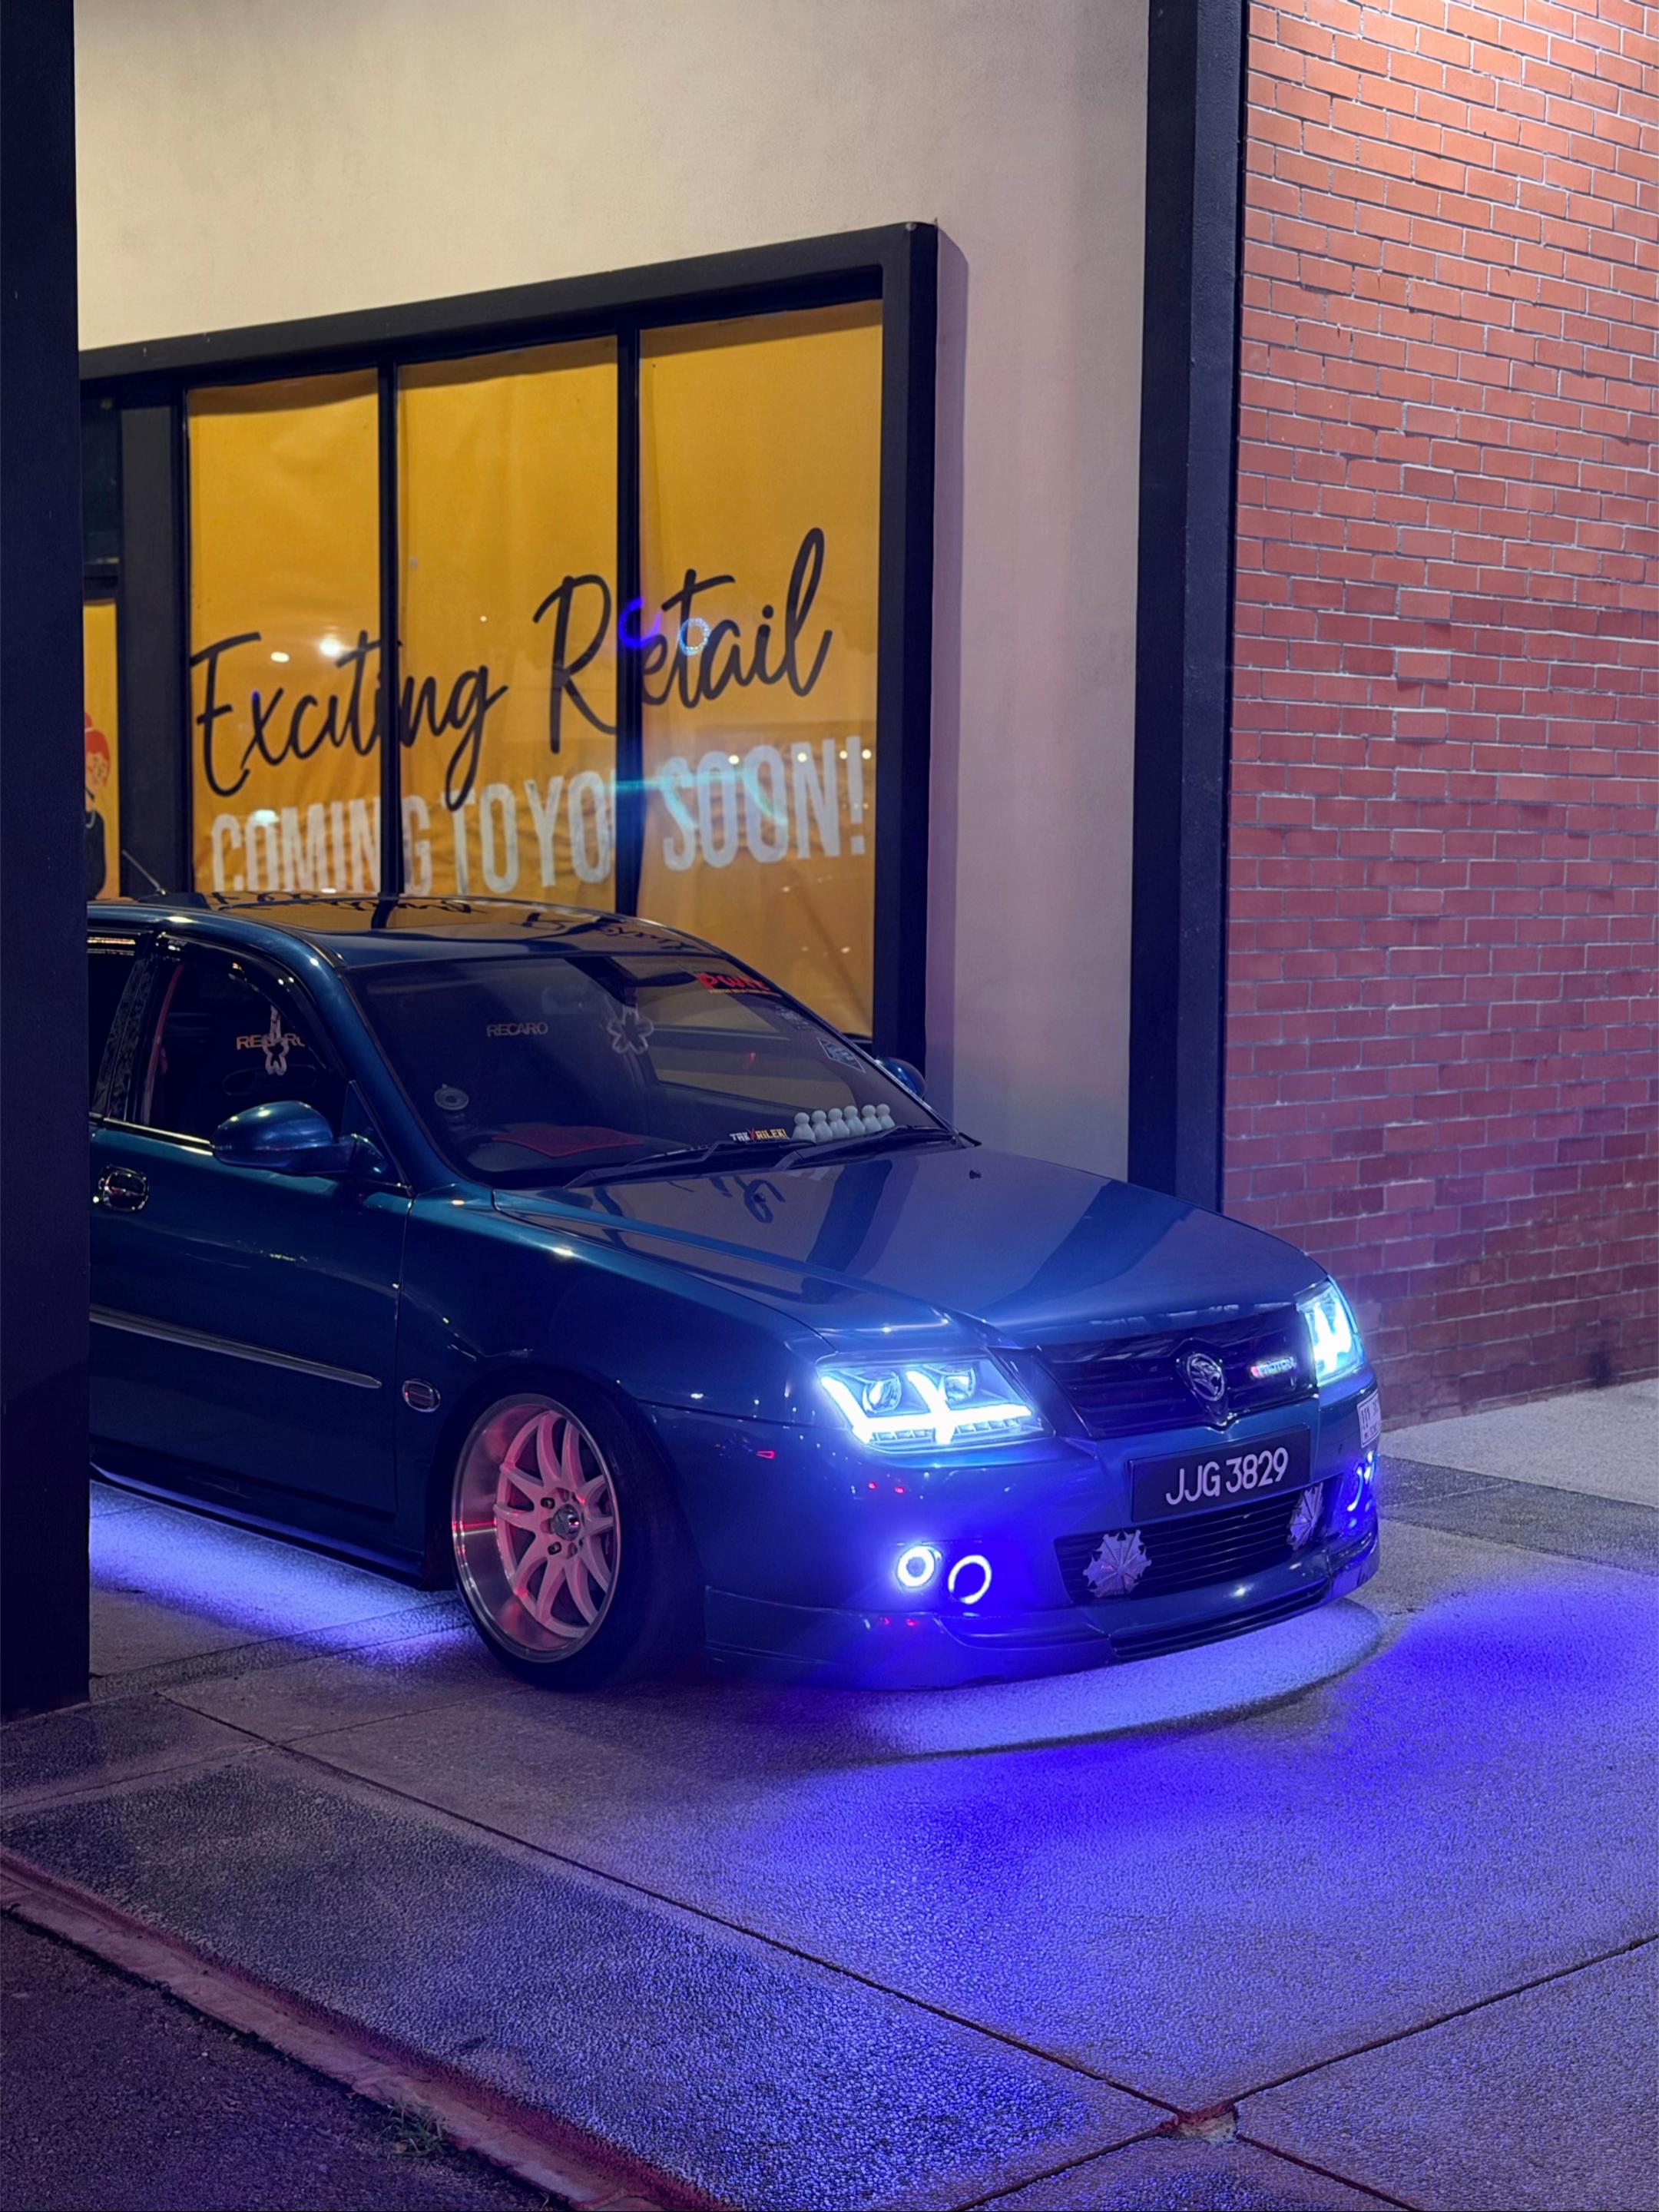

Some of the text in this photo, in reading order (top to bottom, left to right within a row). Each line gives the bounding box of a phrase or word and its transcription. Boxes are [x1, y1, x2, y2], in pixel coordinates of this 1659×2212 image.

[533, 527, 833, 754] Retail
[212, 735, 866, 896] COMING TO YO SOON!
[486, 1022, 549, 1038] RECARO
[1165, 1447, 1289, 1506] JJG 3829
